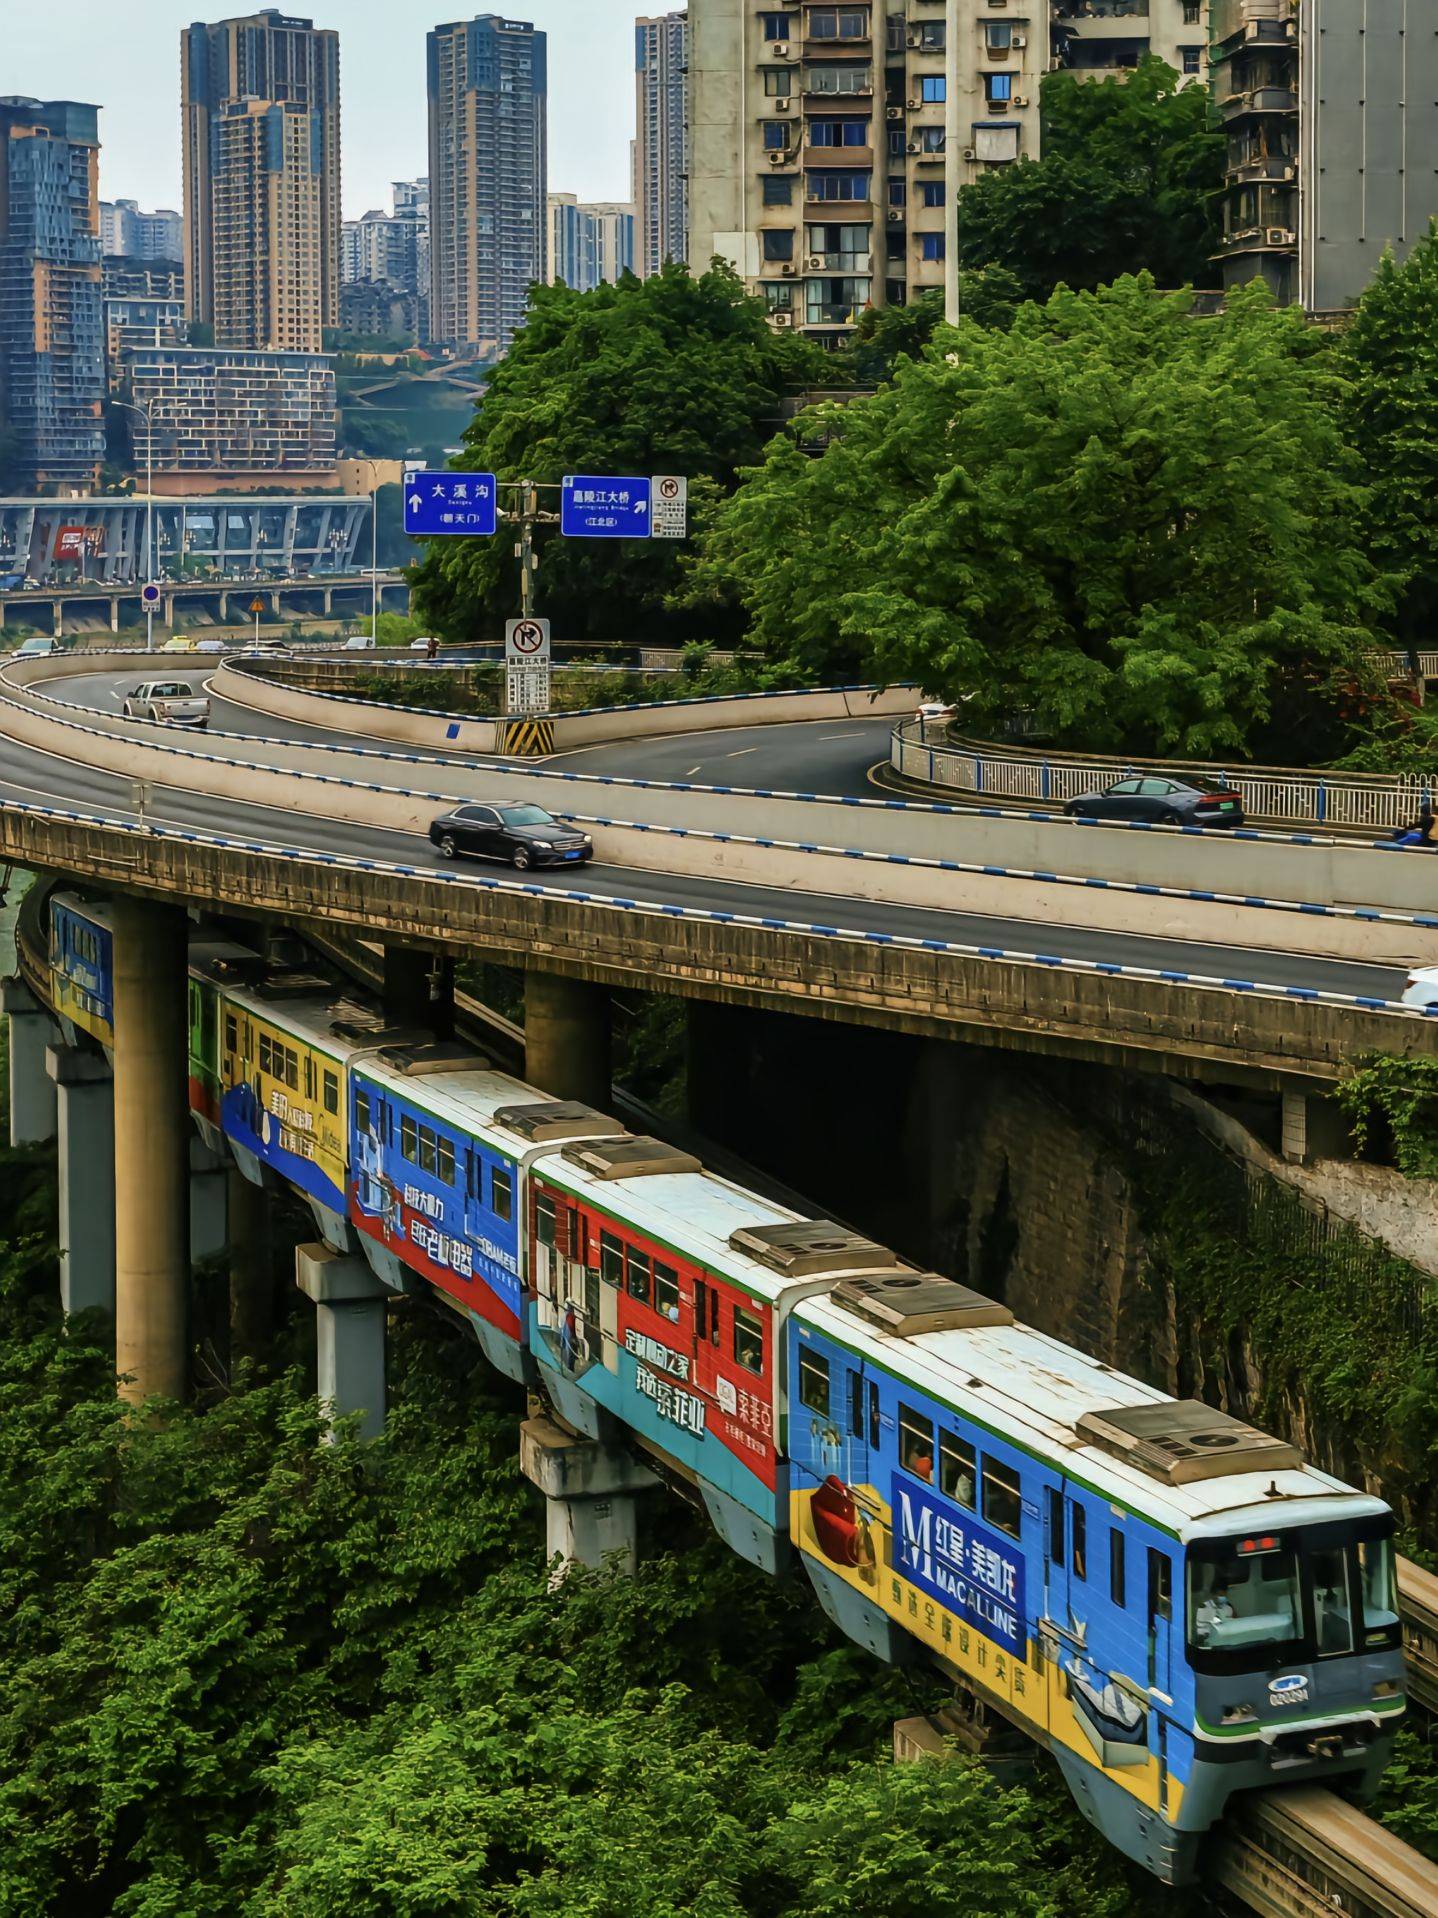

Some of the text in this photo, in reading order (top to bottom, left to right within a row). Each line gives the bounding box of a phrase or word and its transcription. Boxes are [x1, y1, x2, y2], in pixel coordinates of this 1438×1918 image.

[432, 483, 489, 498] 大溪沟
[936, 1564, 1018, 1641] MACALLINE
